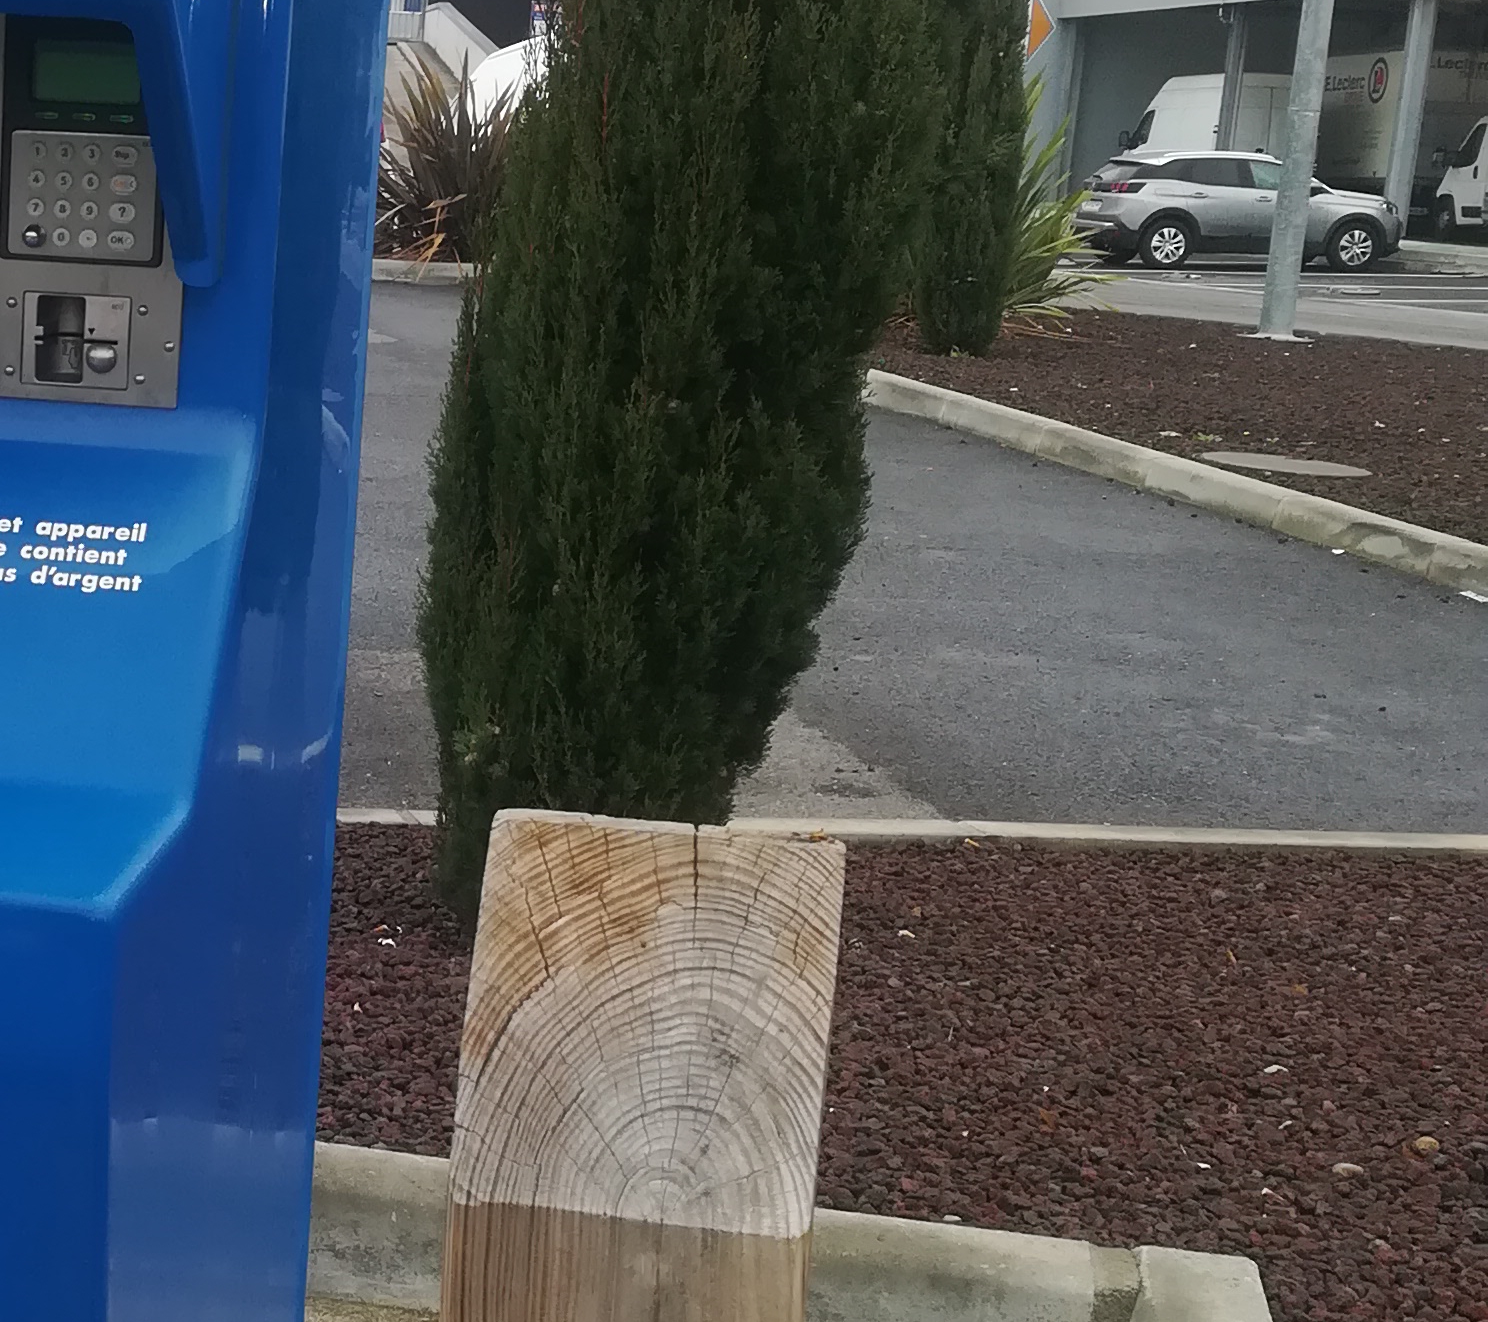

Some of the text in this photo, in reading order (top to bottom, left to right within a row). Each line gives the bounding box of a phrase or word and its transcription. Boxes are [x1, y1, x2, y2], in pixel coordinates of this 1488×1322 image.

[110, 235, 124, 245] OK
[35, 521, 148, 543] appareil
[20, 543, 128, 566] contient
[30, 564, 143, 593] d'argent
